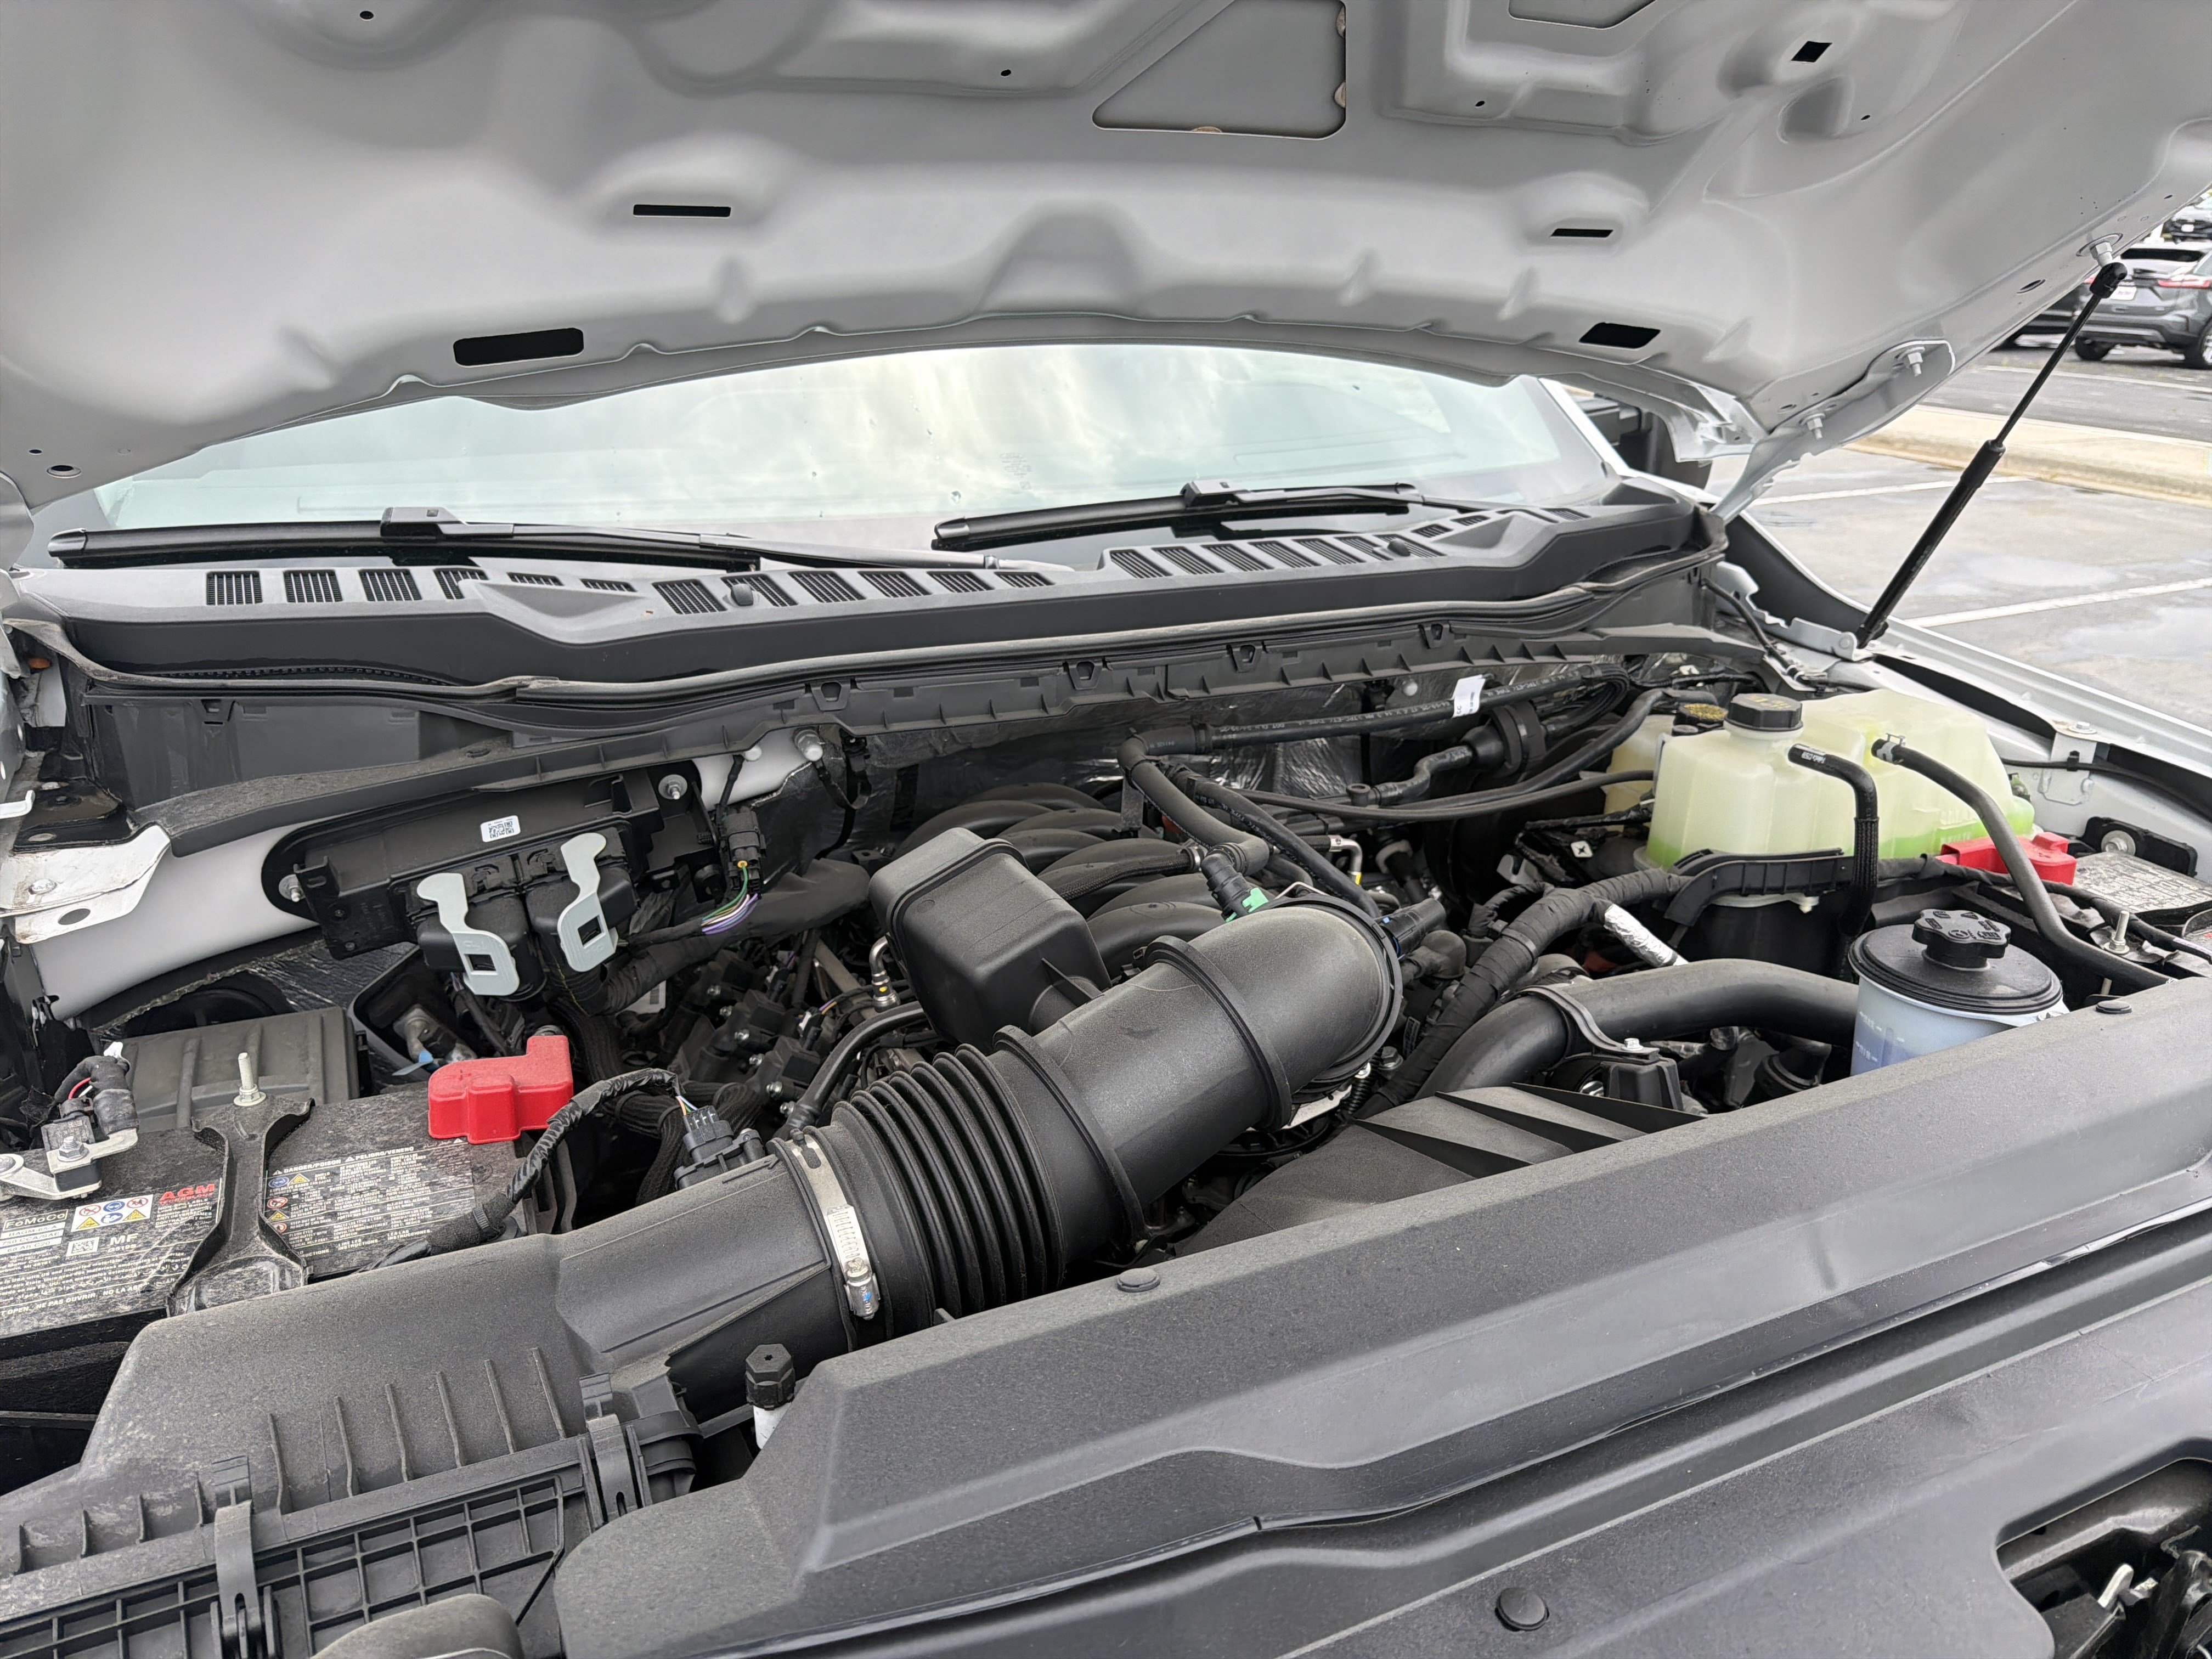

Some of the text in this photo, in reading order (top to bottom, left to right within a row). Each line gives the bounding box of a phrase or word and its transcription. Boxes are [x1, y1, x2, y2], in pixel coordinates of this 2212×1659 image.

[159, 1183, 215, 1200] AGM
[5, 1212, 65, 1228] FoMoCo
[110, 1233, 138, 1245] MF
